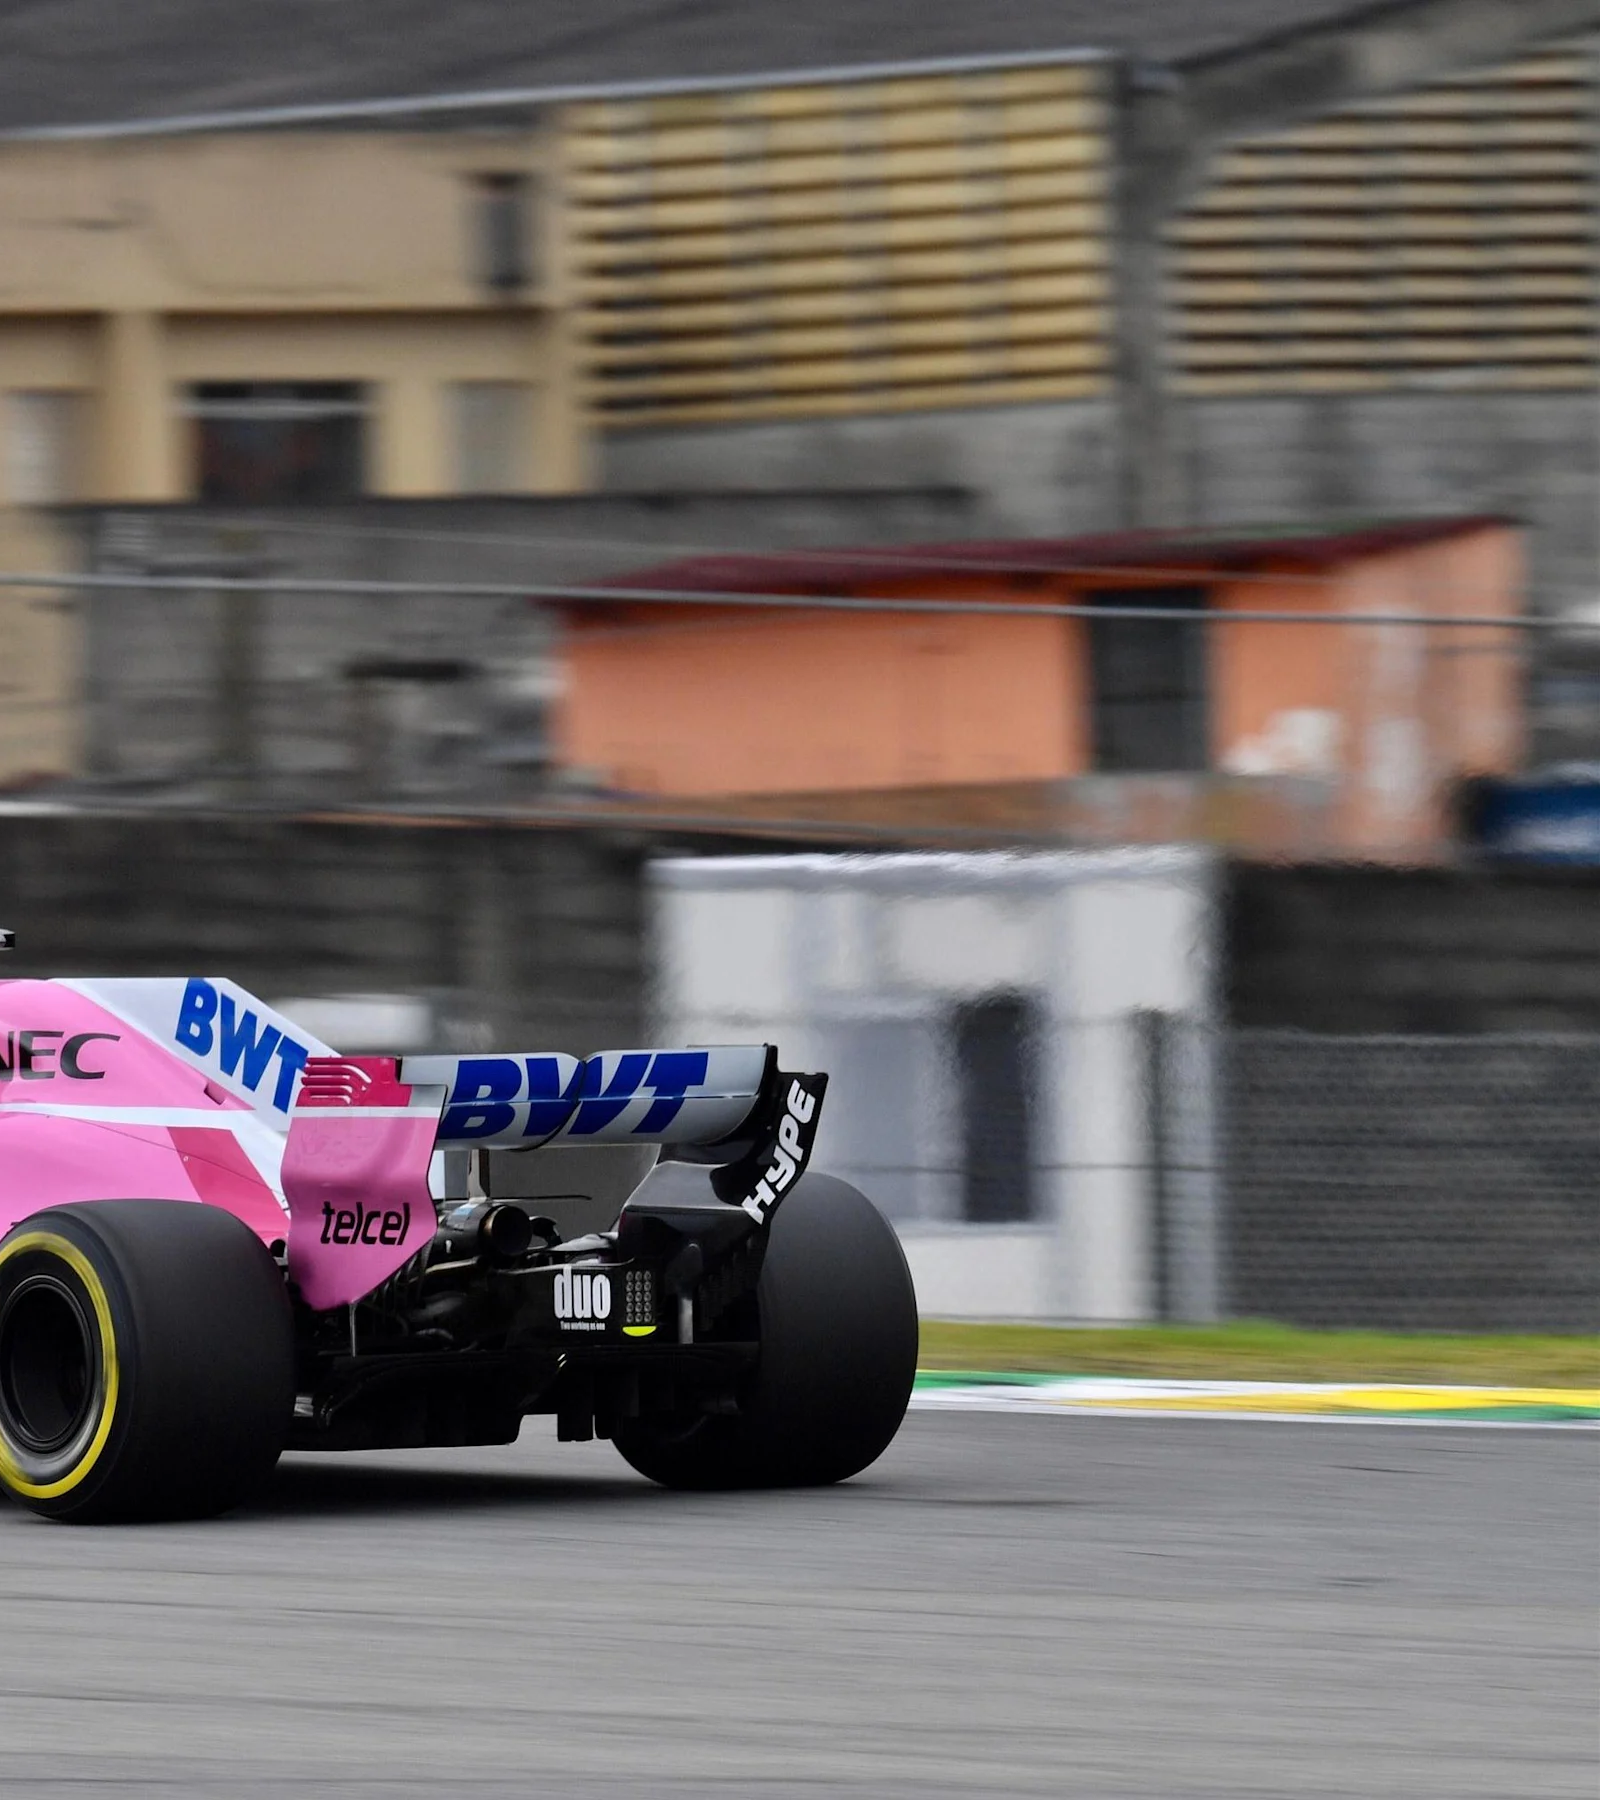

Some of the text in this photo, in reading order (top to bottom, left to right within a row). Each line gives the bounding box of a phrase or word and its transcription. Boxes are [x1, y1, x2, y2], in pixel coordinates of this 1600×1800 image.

[175, 977, 309, 1115] BWT
[438, 1052, 709, 1139] BWT
[741, 1079, 816, 1225] HYPE
[320, 1202, 410, 1246] telcel
[554, 1264, 611, 1319] duo
